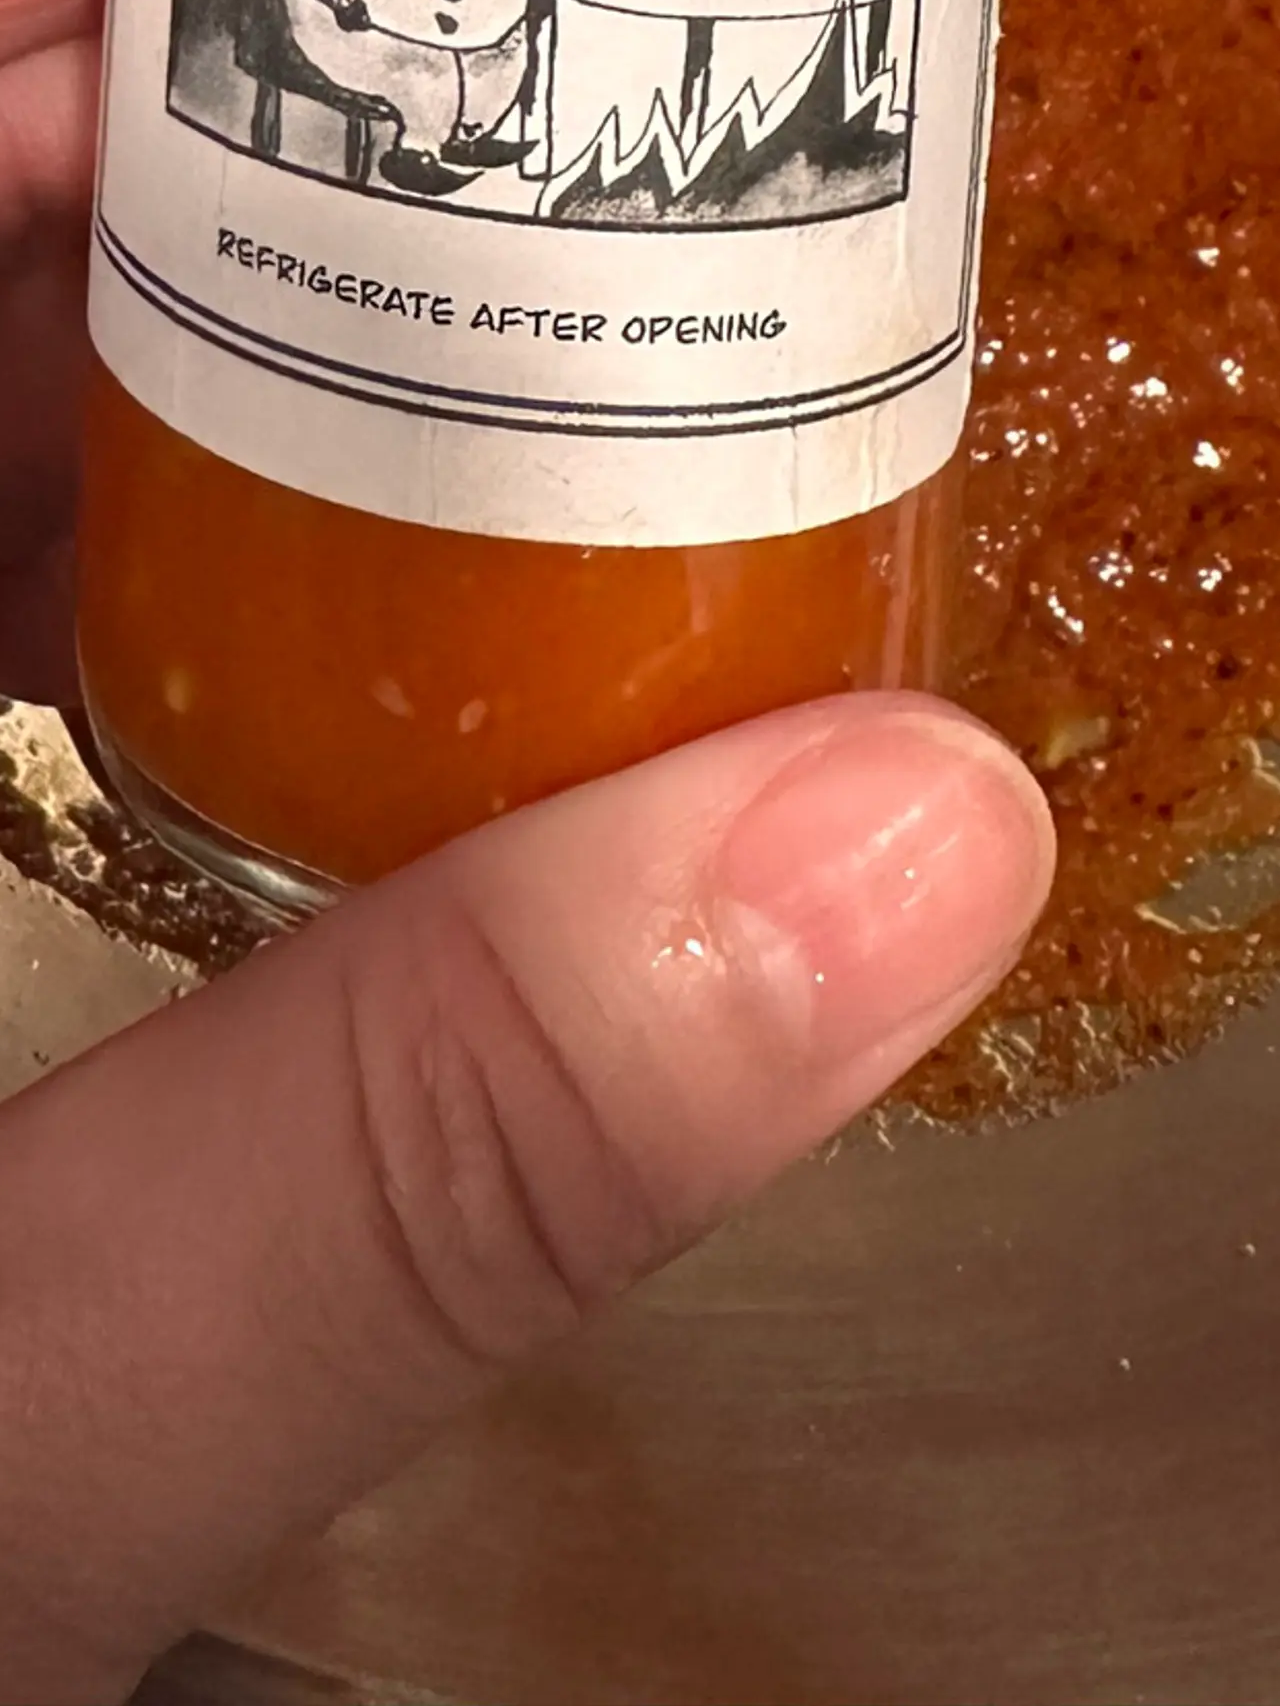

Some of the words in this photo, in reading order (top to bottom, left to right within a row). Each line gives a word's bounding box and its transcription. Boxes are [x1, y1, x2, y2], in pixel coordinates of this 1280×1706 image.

[215, 226, 457, 326] REFRIGERATE
[468, 301, 609, 344] AFTER
[620, 308, 788, 346] OPENING
